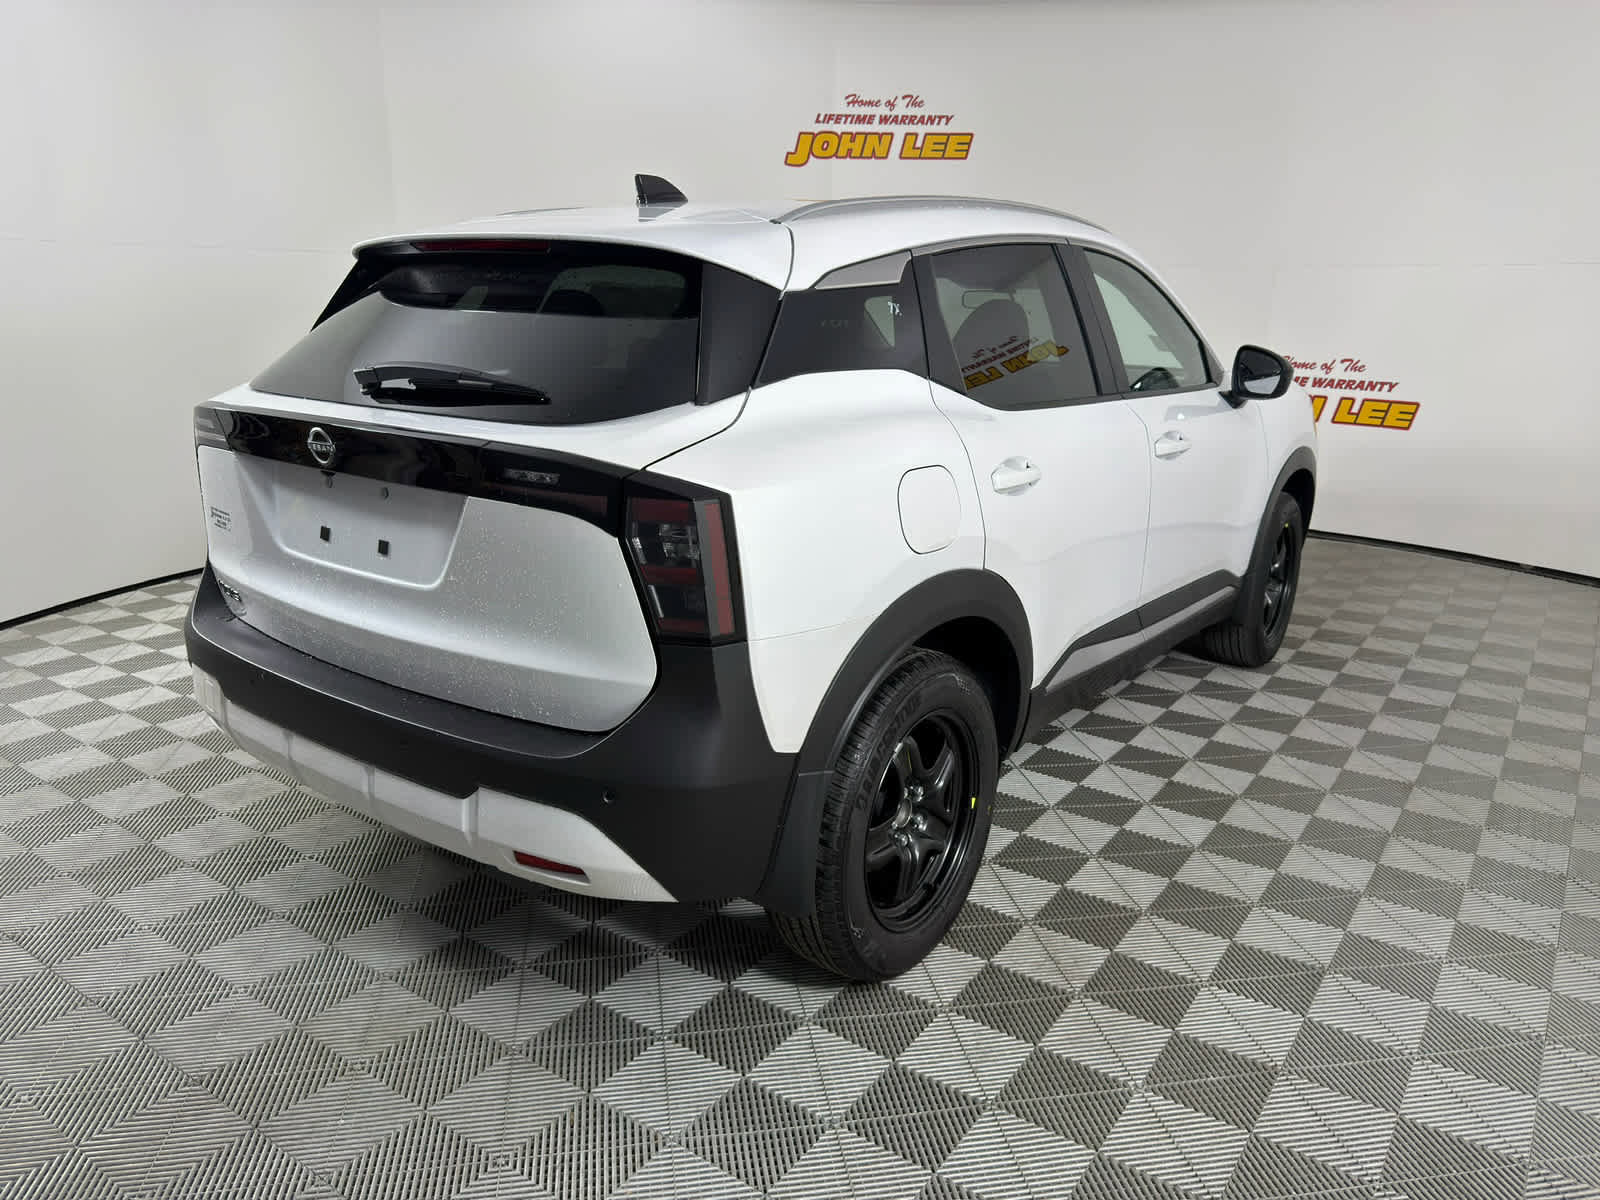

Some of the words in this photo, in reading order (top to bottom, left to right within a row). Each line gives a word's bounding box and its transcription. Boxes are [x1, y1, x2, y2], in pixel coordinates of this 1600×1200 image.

[844, 94, 882, 108] Home
[884, 96, 898, 112] of
[902, 94, 925, 109] The
[815, 113, 876, 125] LIFETIME
[878, 114, 954, 126] WARRANTY
[784, 131, 894, 168] JOHN
[899, 133, 974, 160] LEE
[1320, 359, 1337, 374] of
[1340, 359, 1366, 373] The
[1312, 377, 1399, 392] WARRANTY
[1331, 397, 1421, 430] LEE
